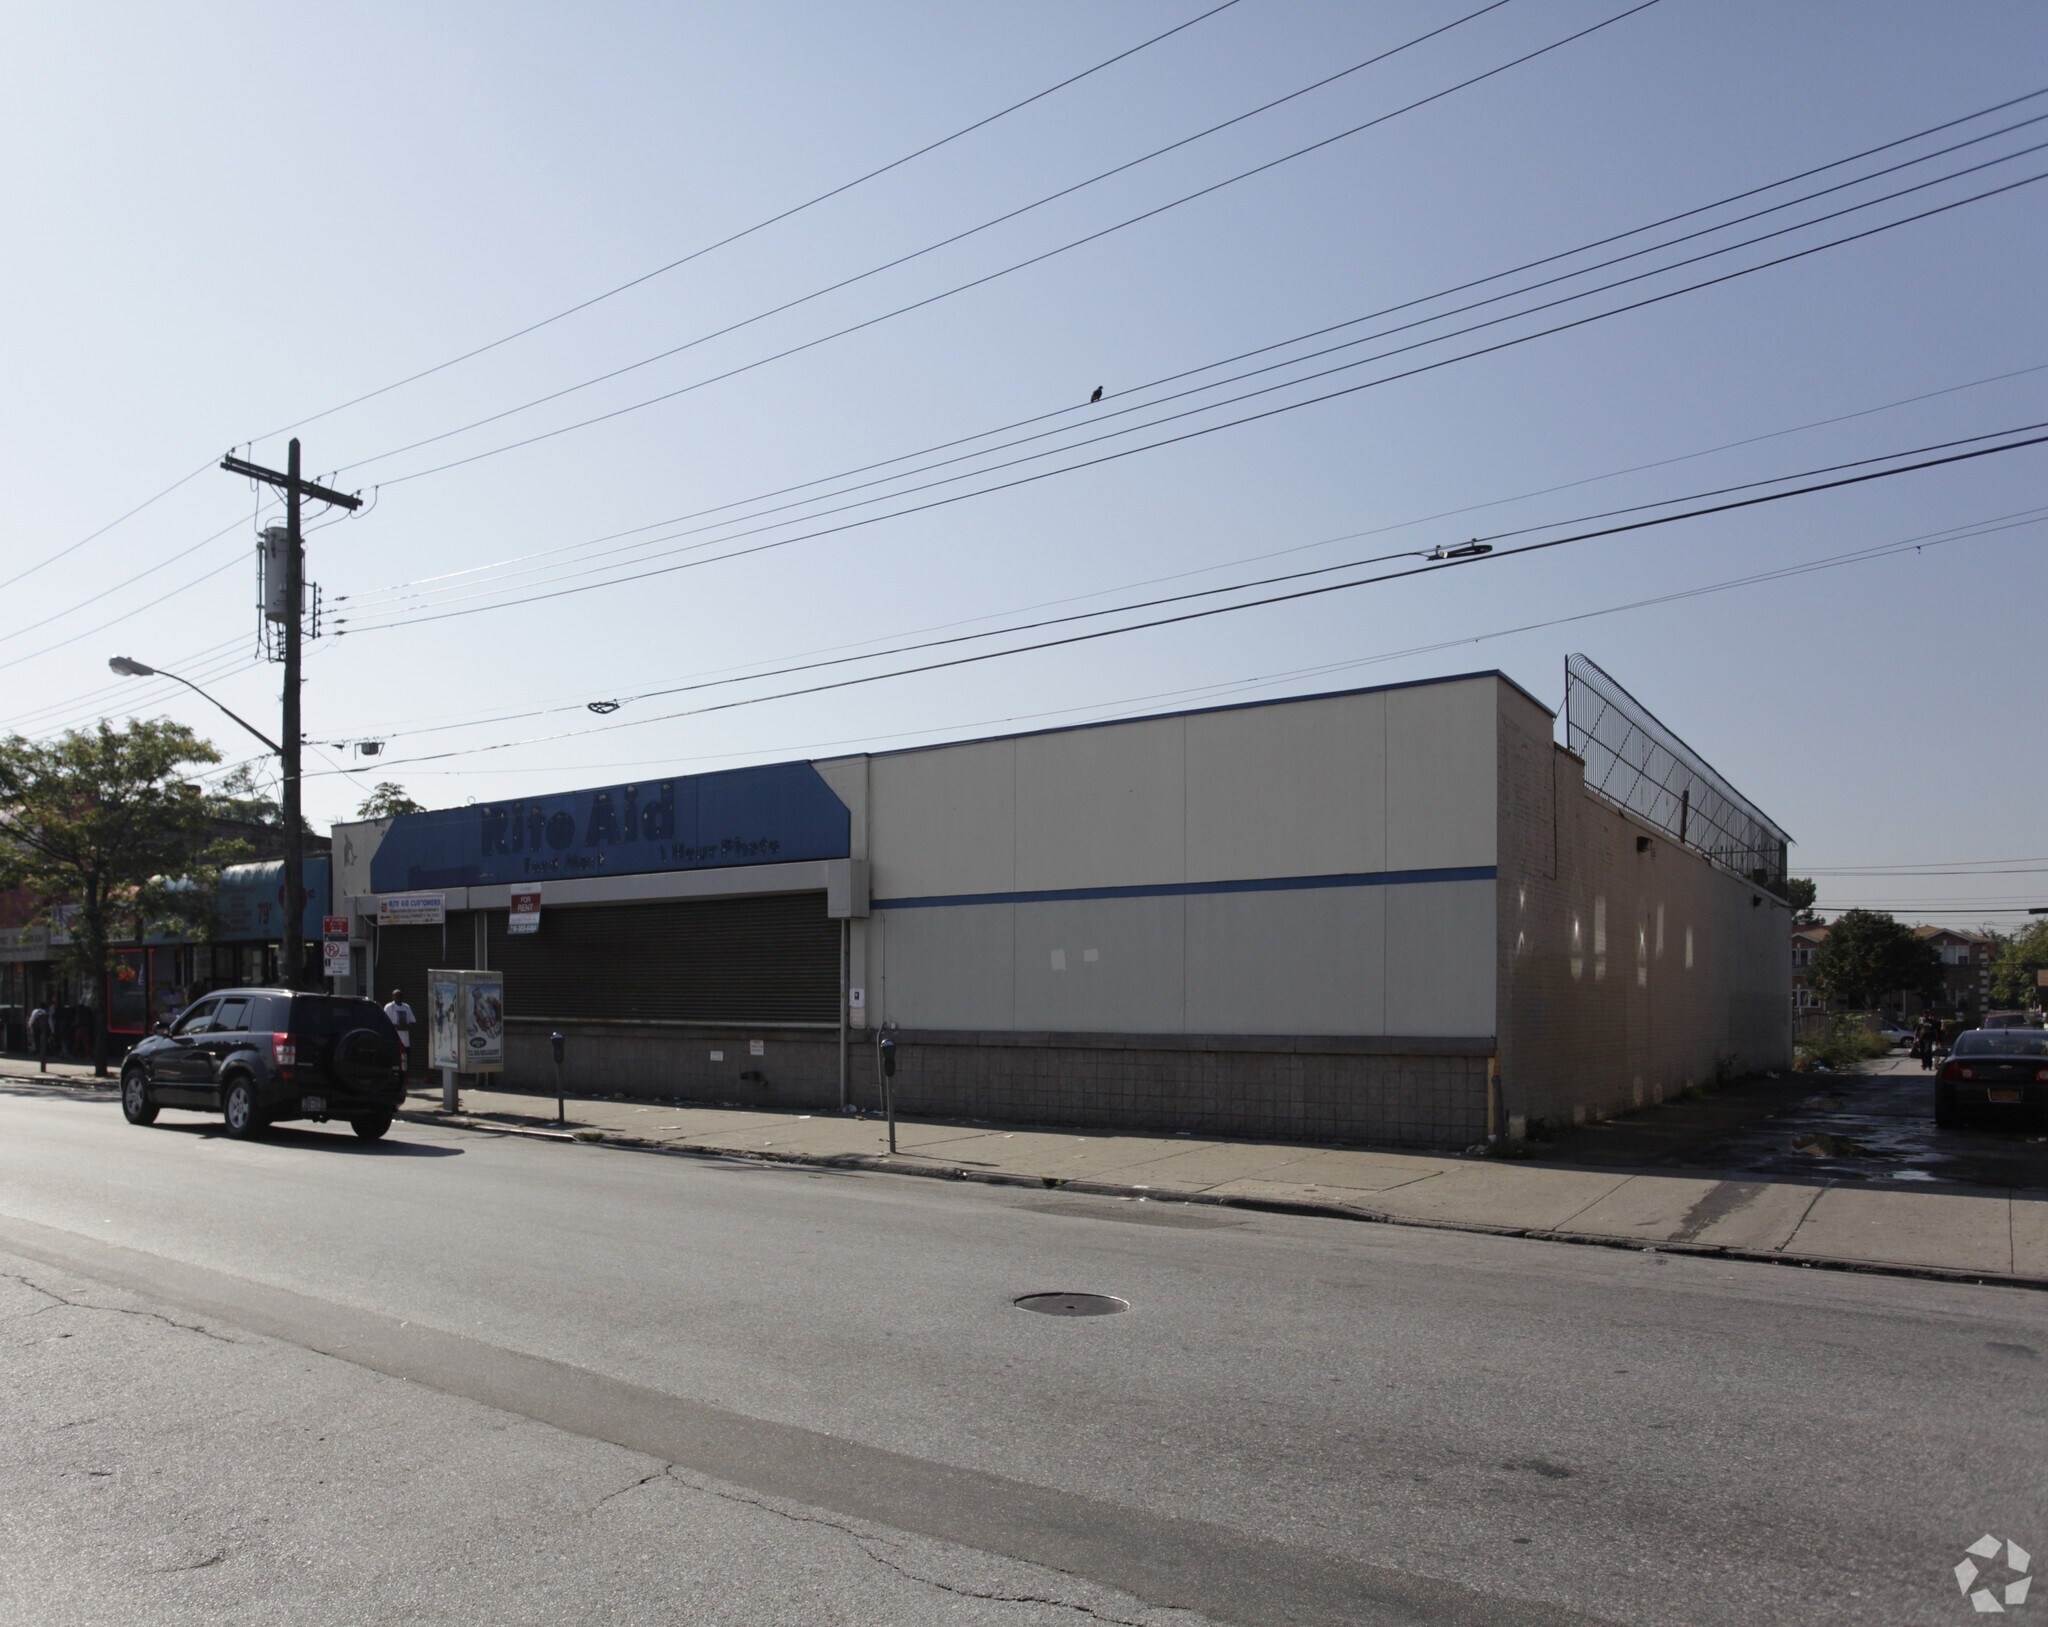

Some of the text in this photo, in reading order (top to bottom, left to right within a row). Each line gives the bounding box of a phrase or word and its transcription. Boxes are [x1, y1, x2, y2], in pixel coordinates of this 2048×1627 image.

[481, 782, 675, 857] Rite Aid
[672, 842, 718, 863] Hour
[721, 837, 780, 859] Photo
[410, 898, 441, 907] CUSTOMERS
[520, 896, 531, 904] FOR
[517, 903, 534, 912] RENT
